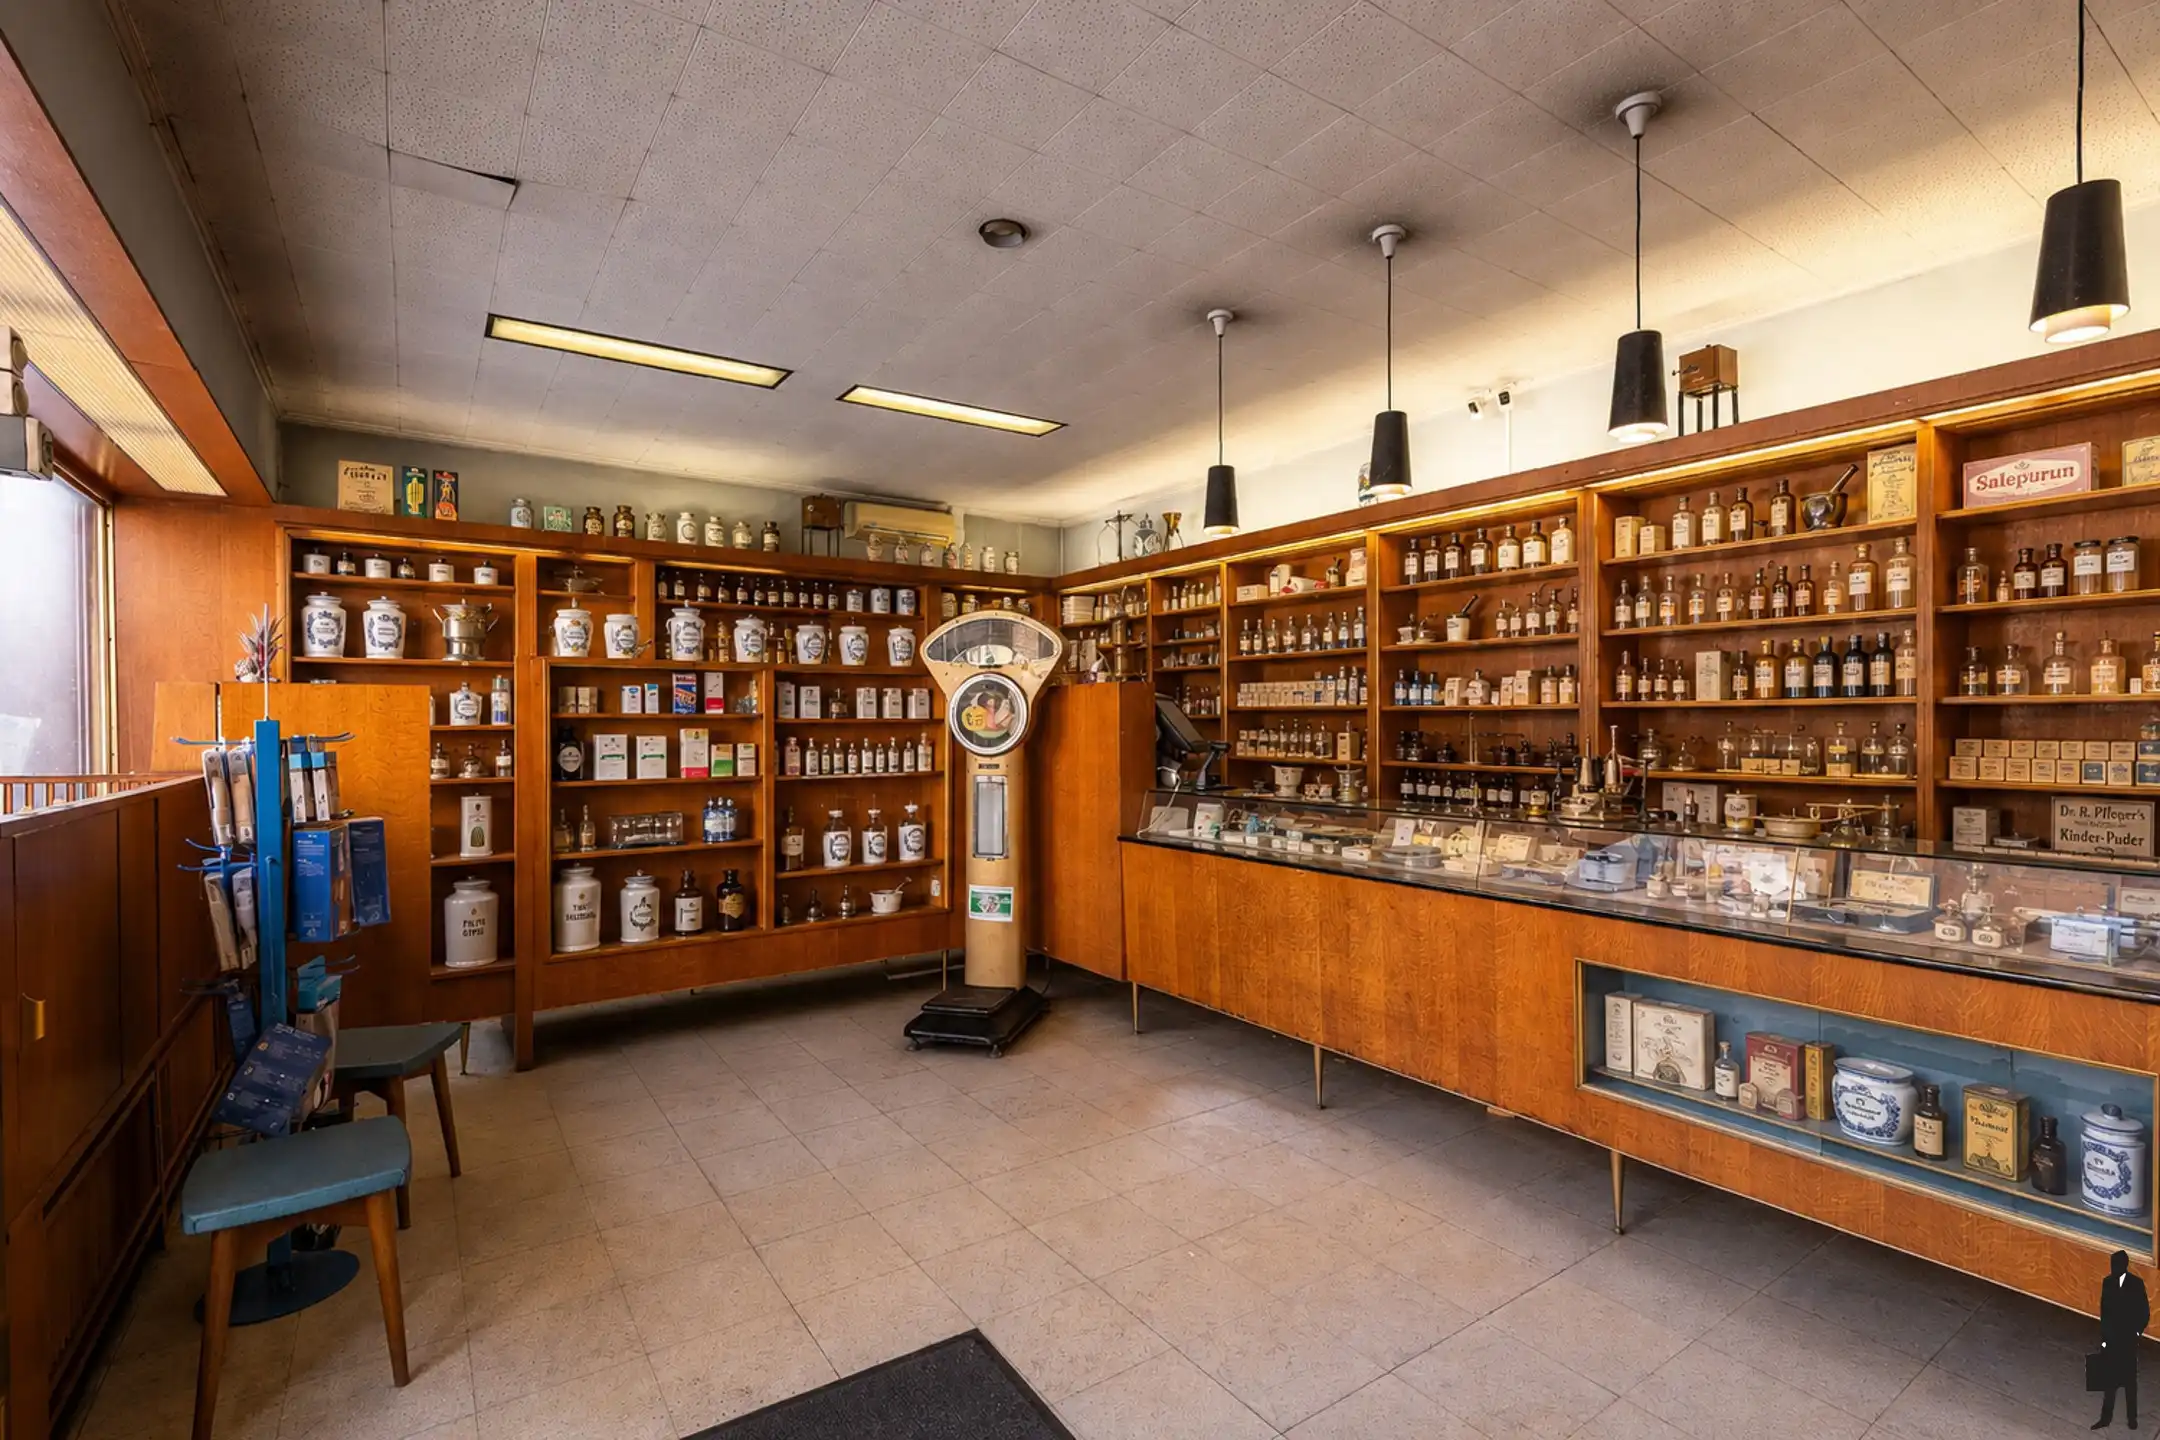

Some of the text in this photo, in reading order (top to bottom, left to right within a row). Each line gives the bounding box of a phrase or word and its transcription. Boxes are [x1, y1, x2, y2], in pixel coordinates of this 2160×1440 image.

[1976, 466, 2075, 491] Salepurun
[2060, 804, 2076, 817] Dr.
[2060, 827, 2145, 847] Kinder-Puder
